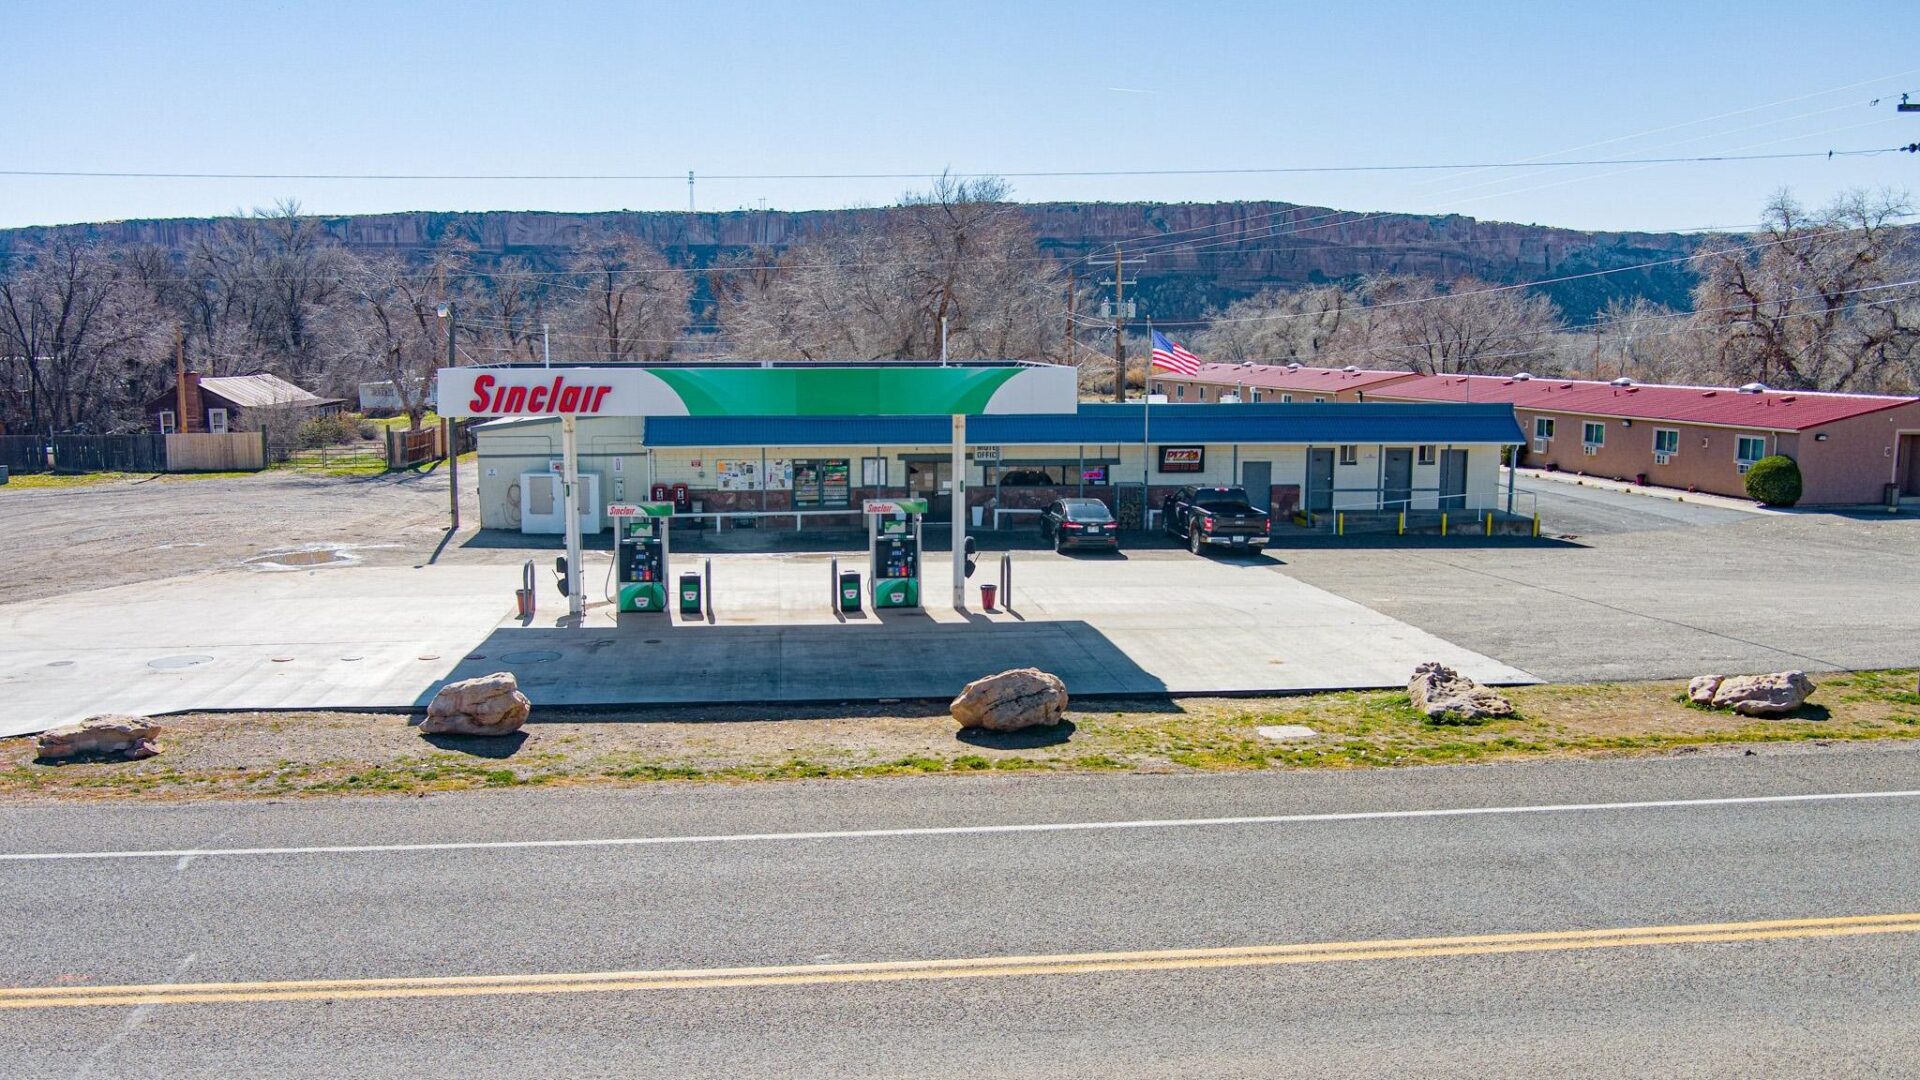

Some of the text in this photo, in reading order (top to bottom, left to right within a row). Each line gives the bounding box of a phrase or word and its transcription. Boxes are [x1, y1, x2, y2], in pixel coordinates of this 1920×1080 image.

[469, 374, 612, 414] Sinclair
[609, 506, 635, 515] Sinclair
[867, 504, 893, 513] Sinclair
